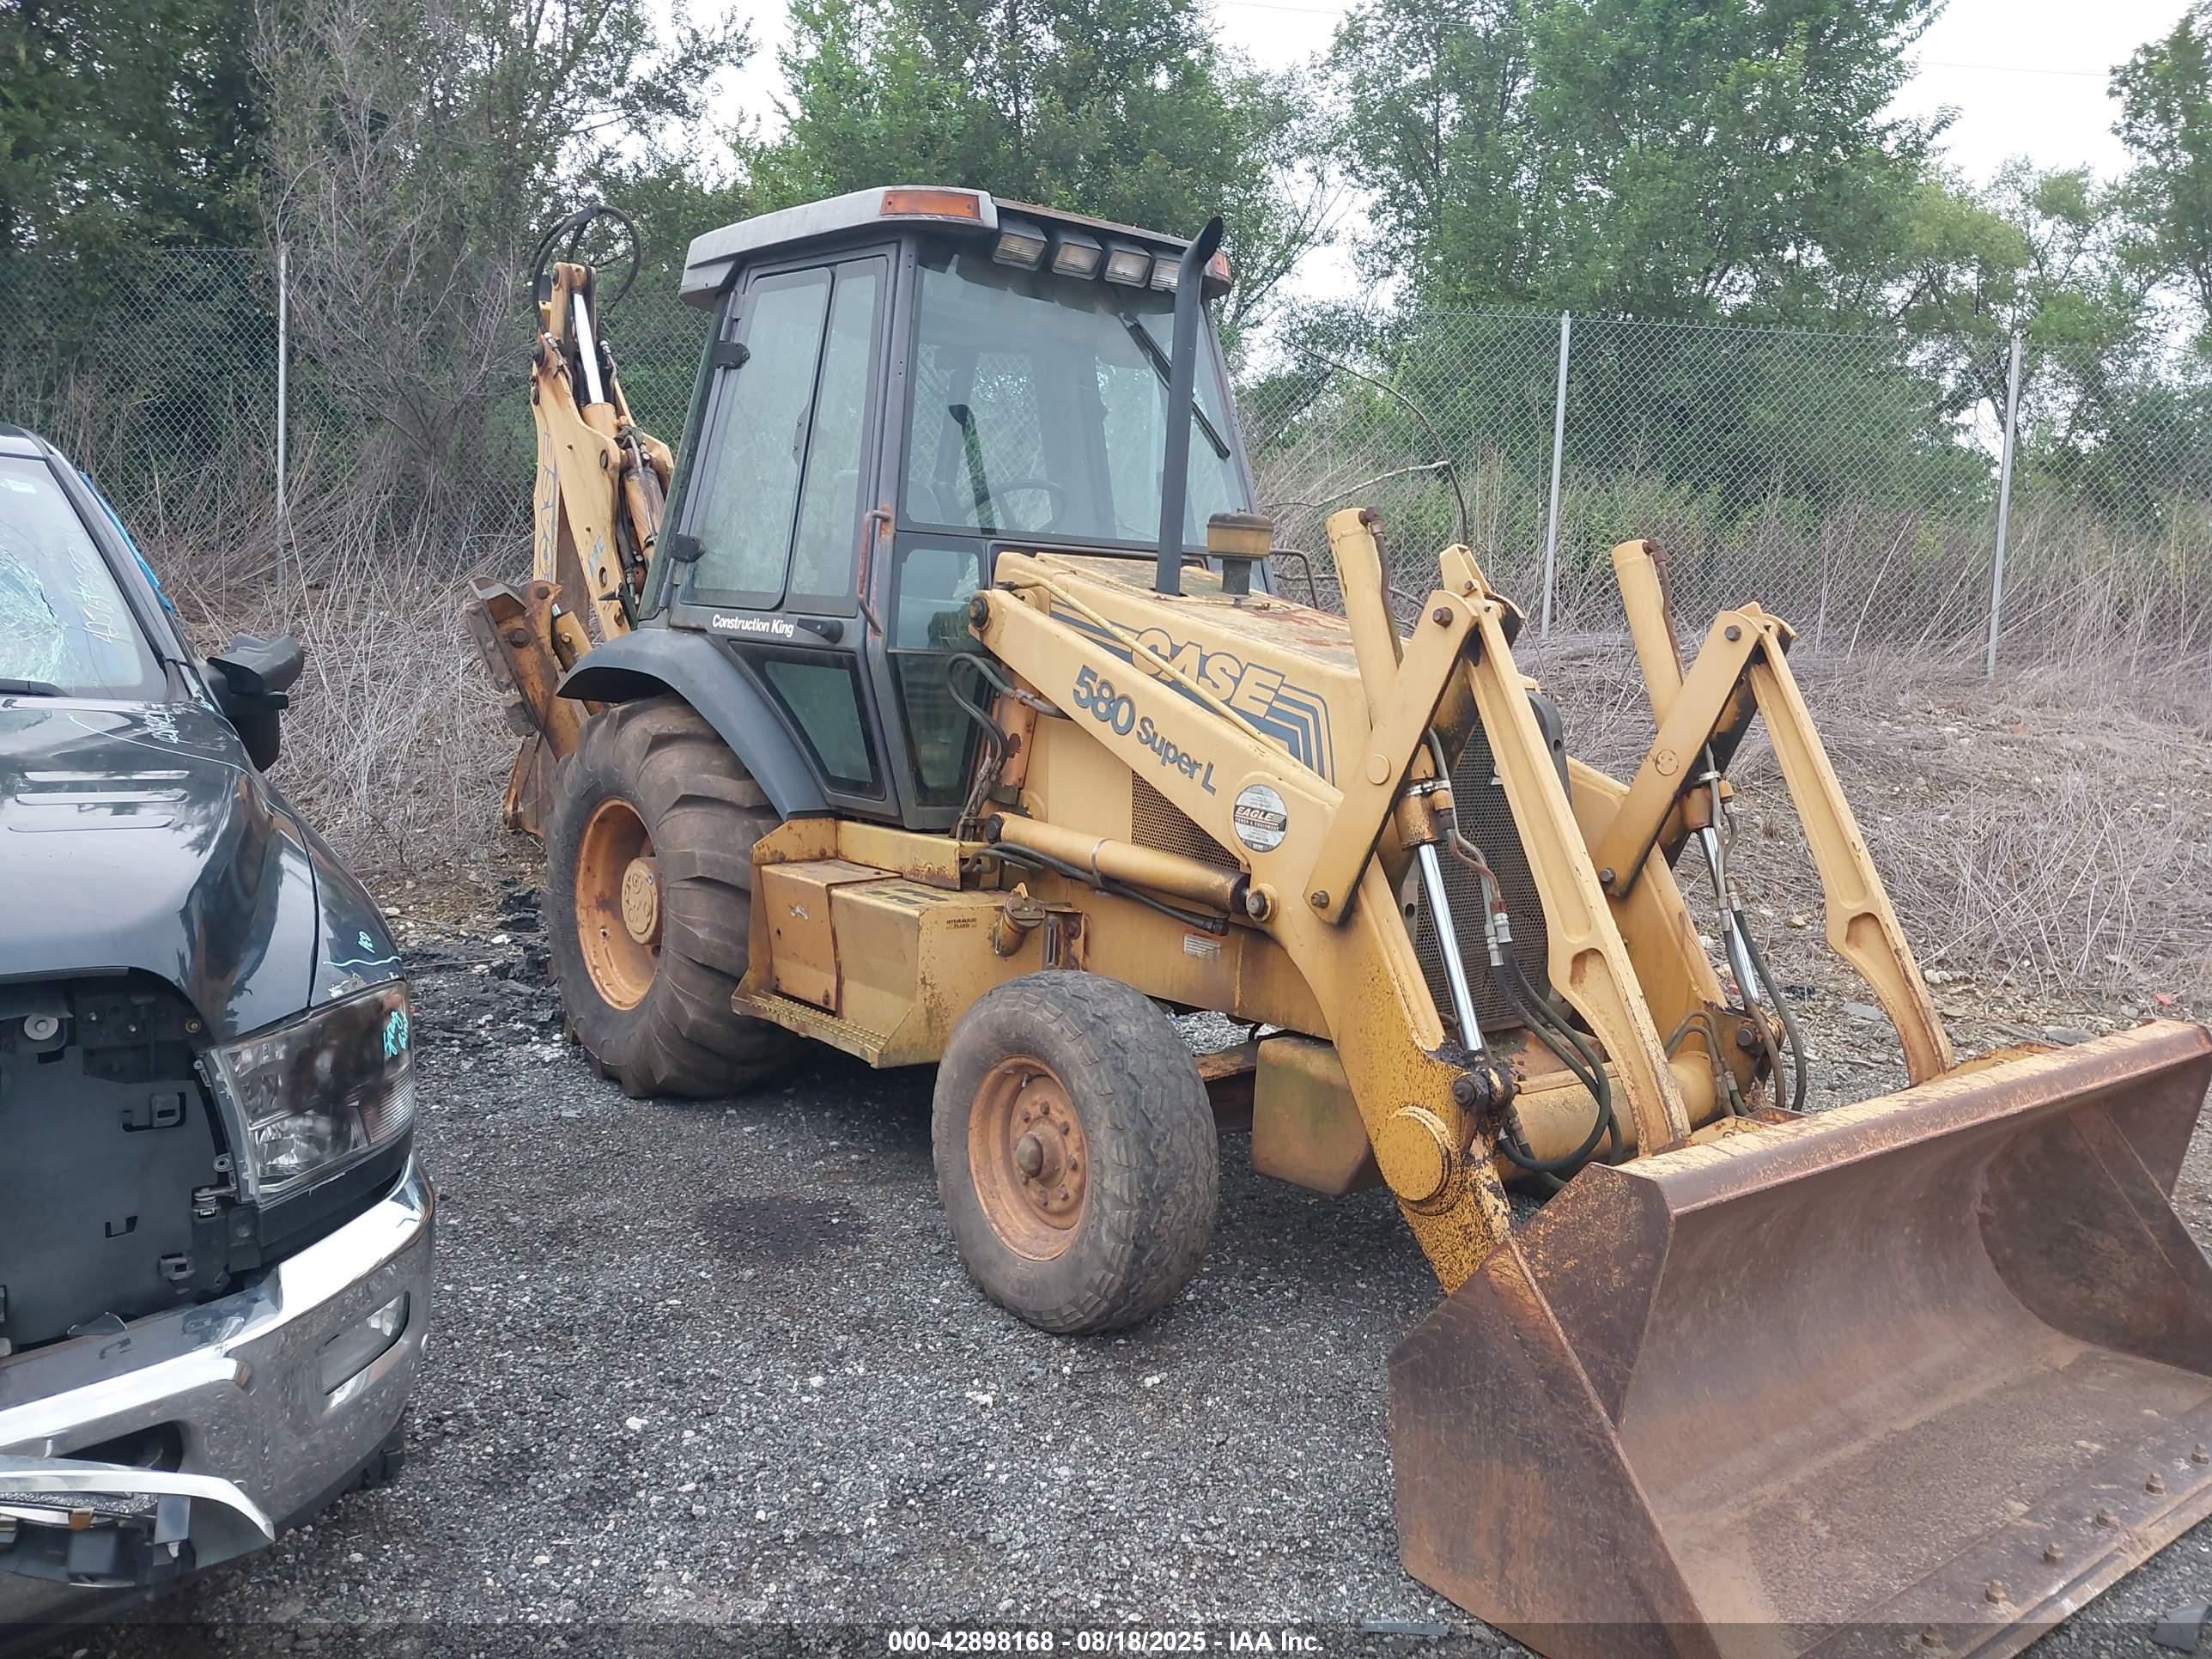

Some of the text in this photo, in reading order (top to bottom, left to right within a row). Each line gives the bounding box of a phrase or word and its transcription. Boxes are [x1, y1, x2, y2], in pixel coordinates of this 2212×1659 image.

[712, 614, 795, 639] Construction King
[1130, 627, 1286, 719] CASE
[1073, 665, 1217, 796] 580 Super L
[1236, 806, 1273, 821] EAGLE
